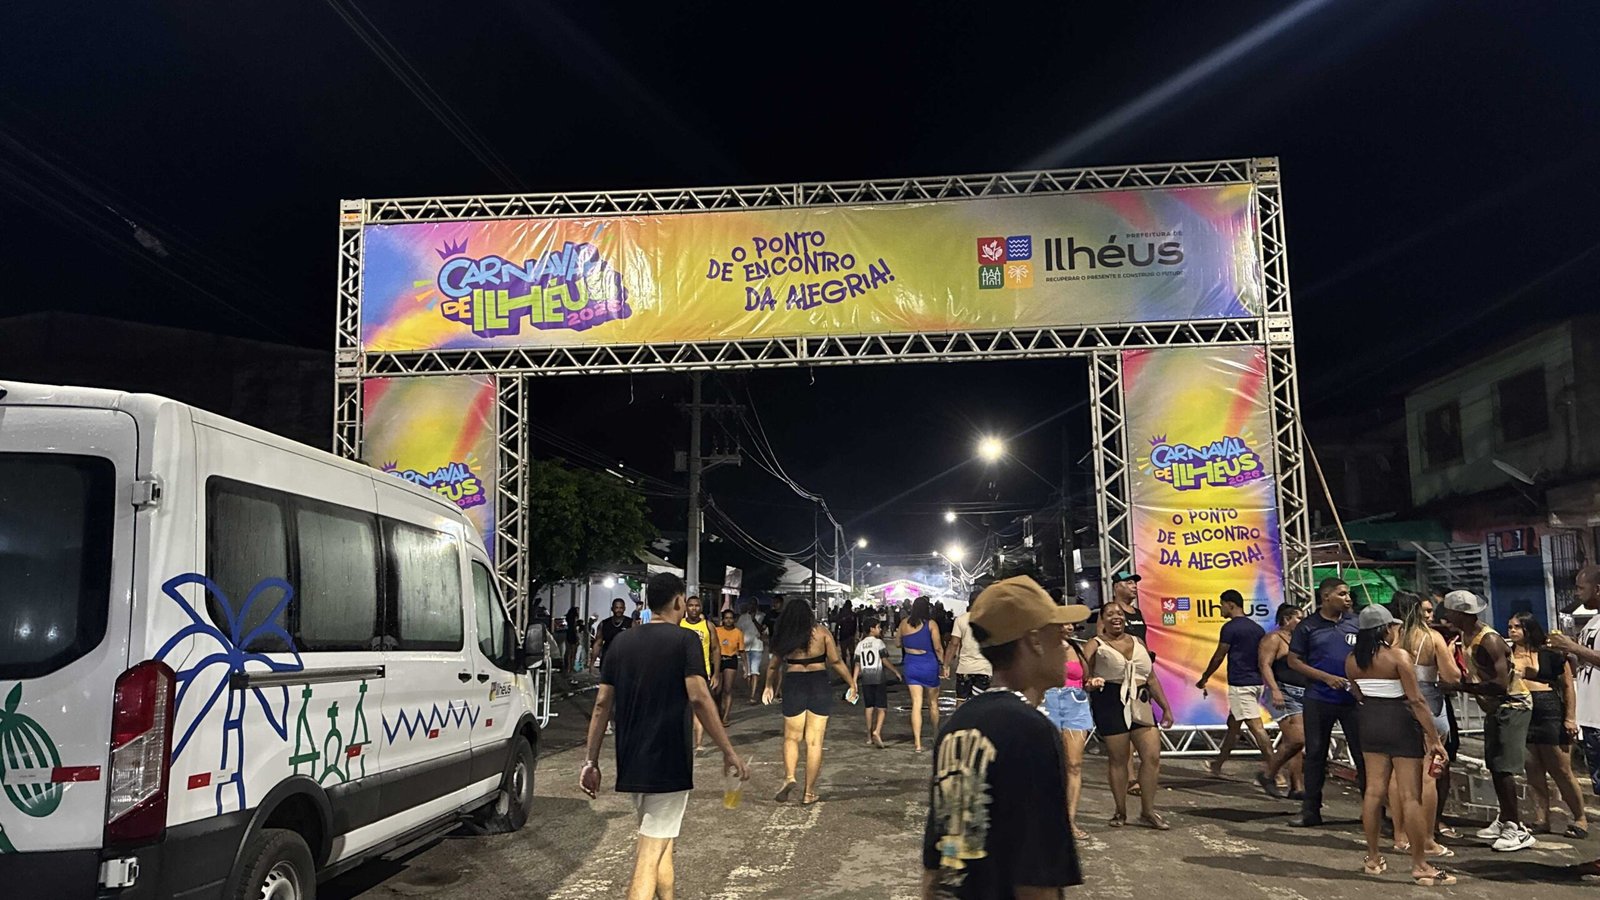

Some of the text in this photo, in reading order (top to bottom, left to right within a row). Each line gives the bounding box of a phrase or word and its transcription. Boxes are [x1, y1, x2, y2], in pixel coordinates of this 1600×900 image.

[732, 231, 825, 262] O PONTO
[1126, 231, 1171, 239] PREFEITURA
[1045, 235, 1184, 271] Ilhéus
[706, 251, 855, 282] DE ENCONTRO
[745, 258, 895, 311] DA ALEGRIA!
[443, 296, 472, 318] DE
[567, 300, 622, 326] 2026
[1151, 437, 1246, 468] CARNAVAL
[1155, 454, 1257, 487] DE ILHÉUS
[1228, 470, 1260, 485] 2026
[457, 495, 481, 506] 026
[1172, 508, 1238, 525] O PONTO
[1157, 525, 1260, 545] DE ENCONTRO
[1159, 543, 1264, 570] DA ALEGRIA!
[1197, 599, 1269, 617] Ilhus
[861, 650, 875, 666] 10
